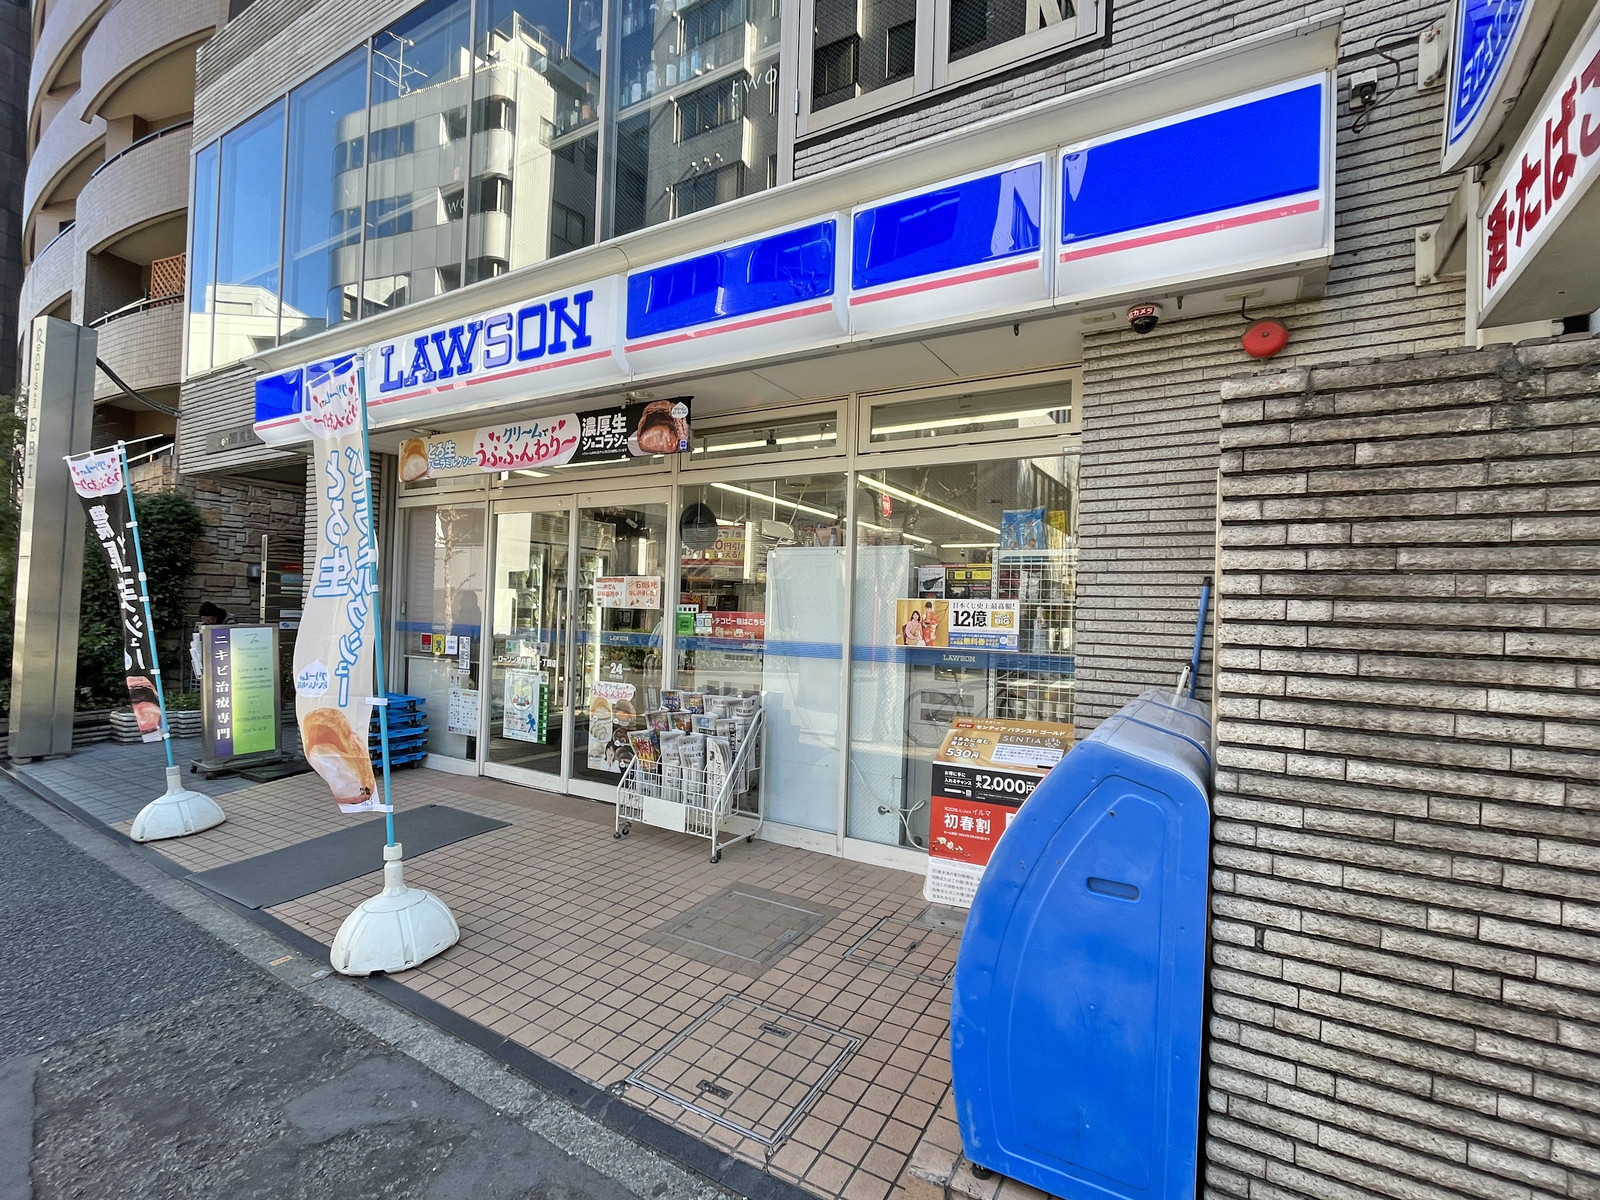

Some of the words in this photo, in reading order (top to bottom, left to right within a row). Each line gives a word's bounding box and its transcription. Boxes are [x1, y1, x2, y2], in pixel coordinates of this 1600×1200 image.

[380, 289, 594, 392] LAWSON
[581, 412, 628, 437] 濃厚生
[503, 422, 549, 444] クリームで
[428, 440, 457, 459] とろ生
[953, 602, 1015, 610] 日本くじ史上最高額！
[953, 610, 987, 628] 12億
[943, 654, 976, 662] LAWSON
[609, 662, 623, 675] 24
[214, 635, 231, 741] ニキビ治療専門
[976, 724, 1007, 732] センティア
[1002, 735, 1042, 744] SENTIA
[945, 747, 979, 759] 530円
[944, 778, 973, 786] 入れるチャンス
[943, 812, 991, 835] 初春割
